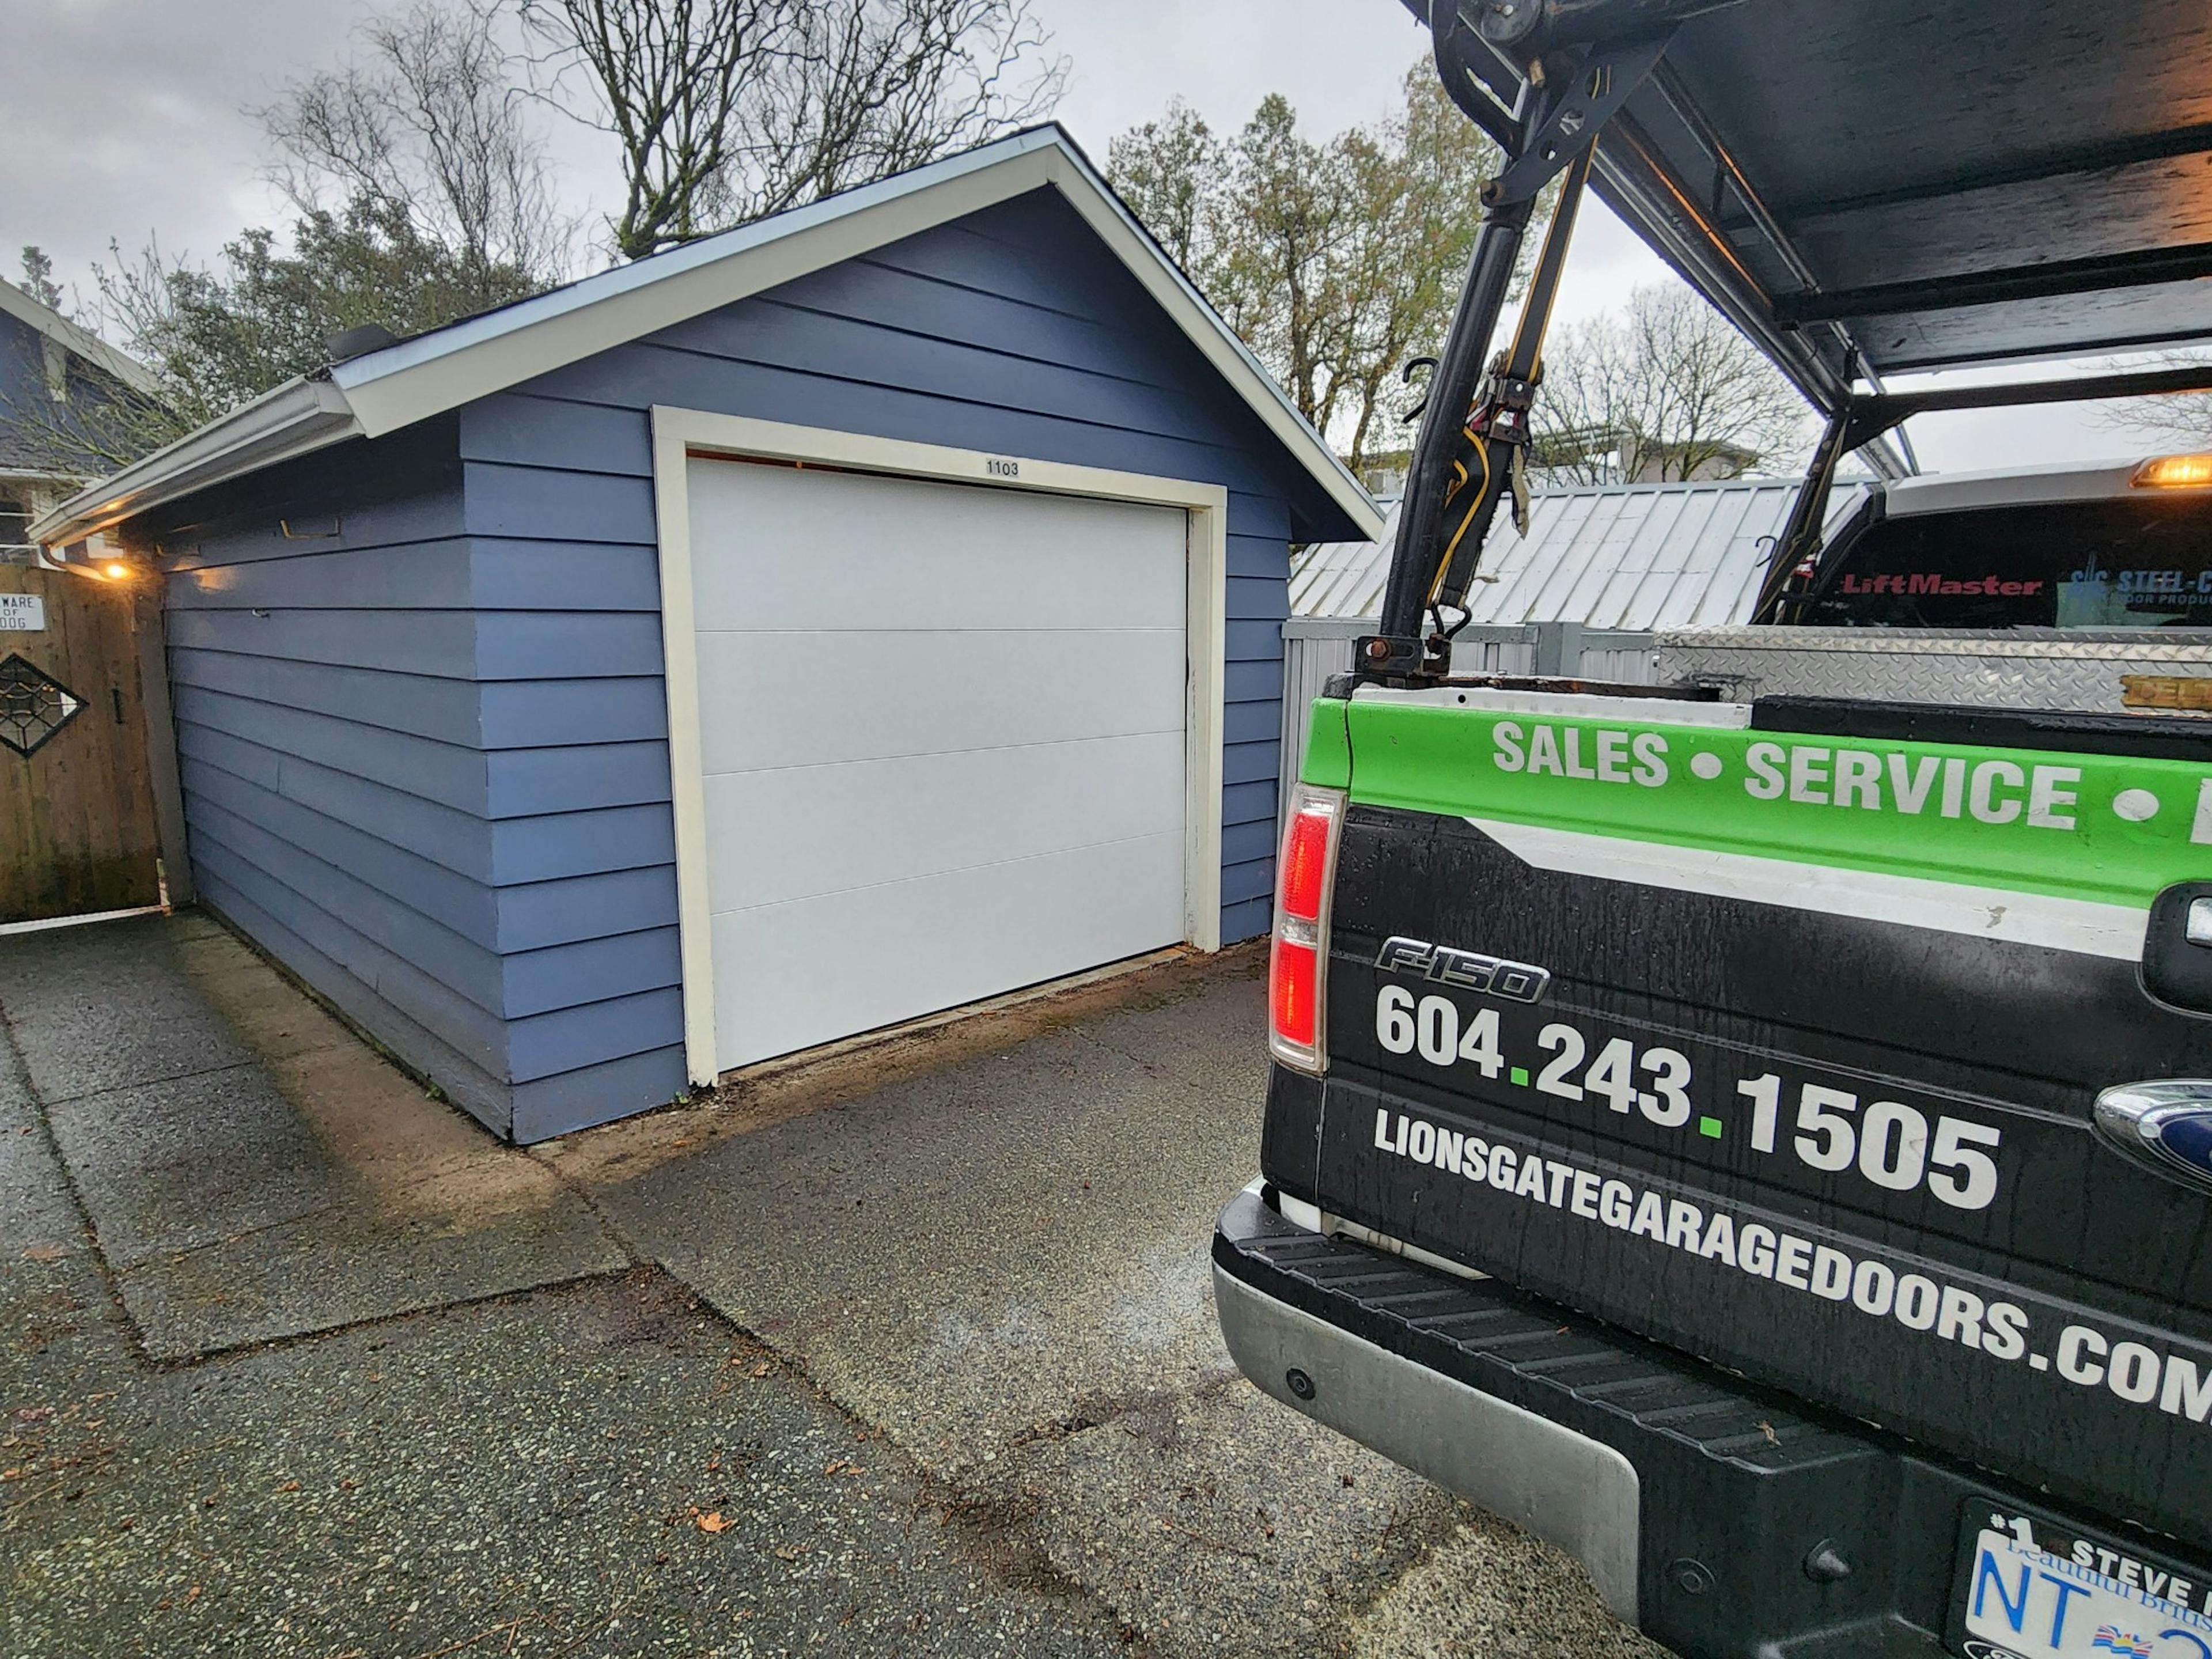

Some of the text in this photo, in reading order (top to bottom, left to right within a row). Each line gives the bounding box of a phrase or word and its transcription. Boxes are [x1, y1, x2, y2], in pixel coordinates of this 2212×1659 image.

[987, 460, 1018, 475] 1103
[2, 597, 35, 608] WARE
[1842, 574, 2043, 596] LiftMaster
[0, 618, 25, 628] DOG
[1492, 721, 2081, 830] SALES SERVICE
[1373, 935, 1551, 1004] F-150
[1376, 984, 2001, 1210] 604.243.1505
[1374, 1108, 2212, 1426] LIONSGATEGARAGEDOORS.COM
[1990, 1513, 2041, 1555] #1
[2071, 1540, 2192, 1608] STEVE
